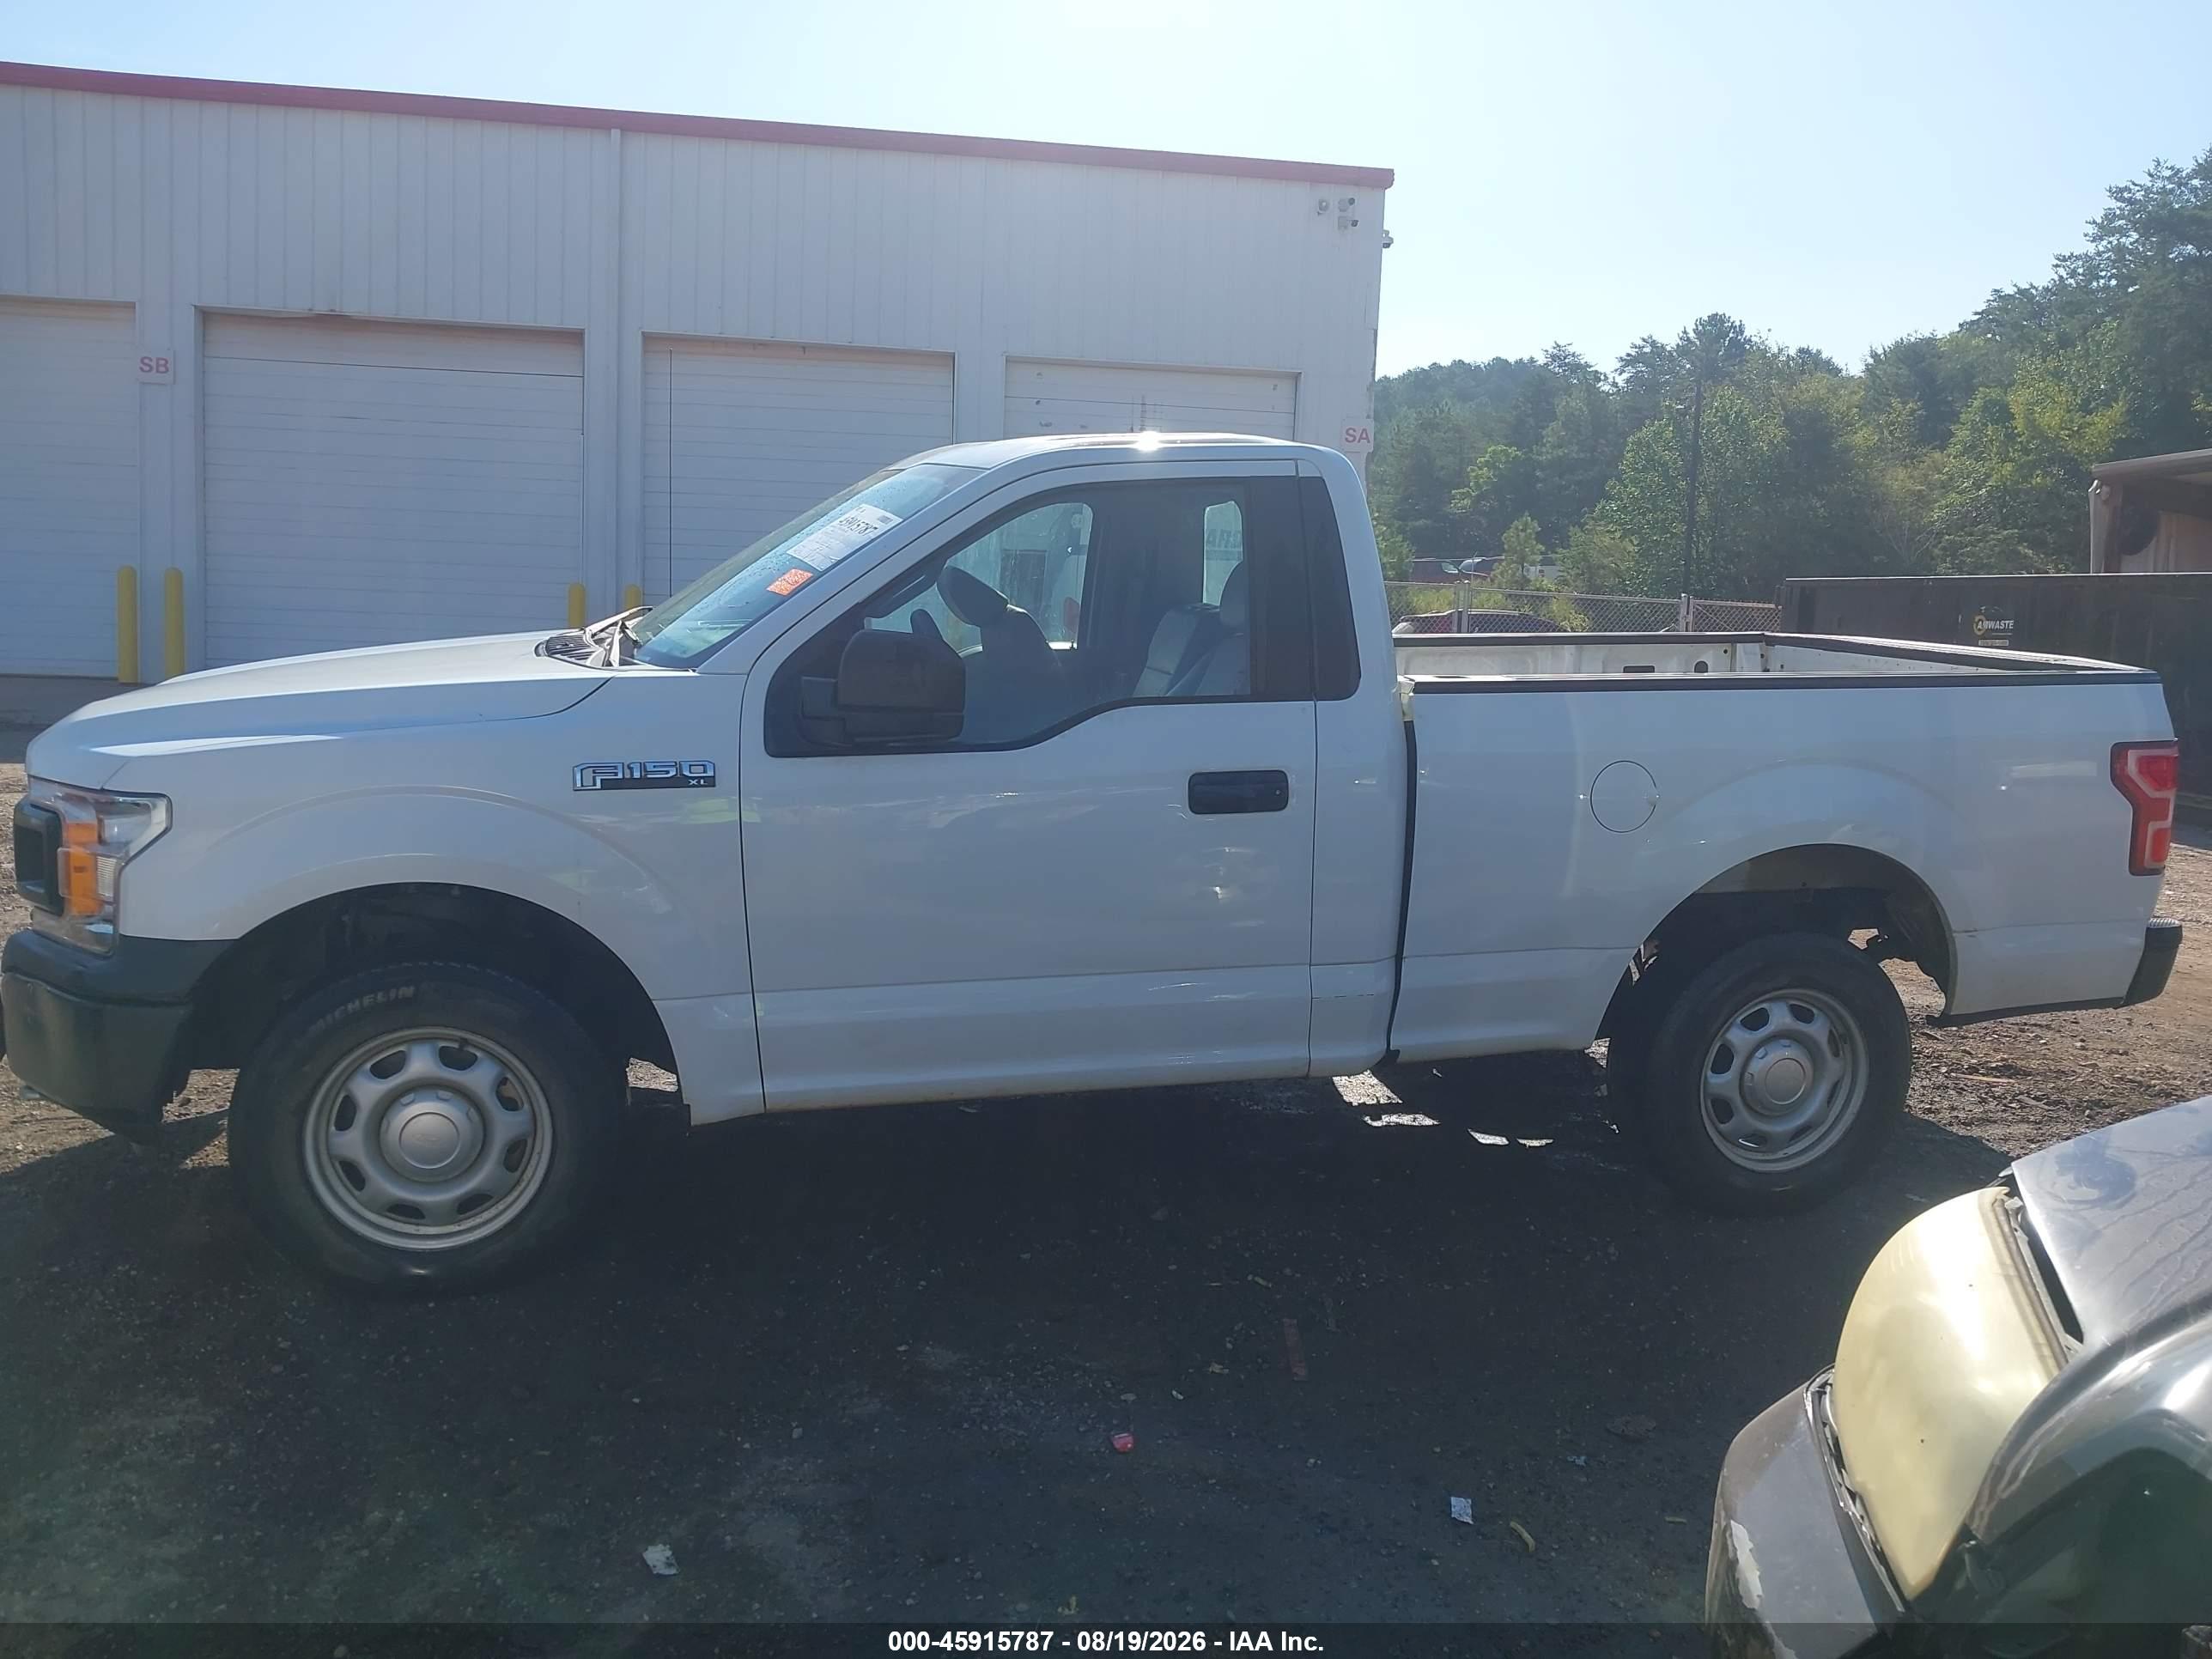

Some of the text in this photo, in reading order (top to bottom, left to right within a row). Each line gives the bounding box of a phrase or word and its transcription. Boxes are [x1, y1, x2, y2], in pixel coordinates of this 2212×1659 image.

[139, 356, 169, 374] SB
[1345, 427, 1370, 444] SA
[307, 985, 416, 1038] MICHELIN
